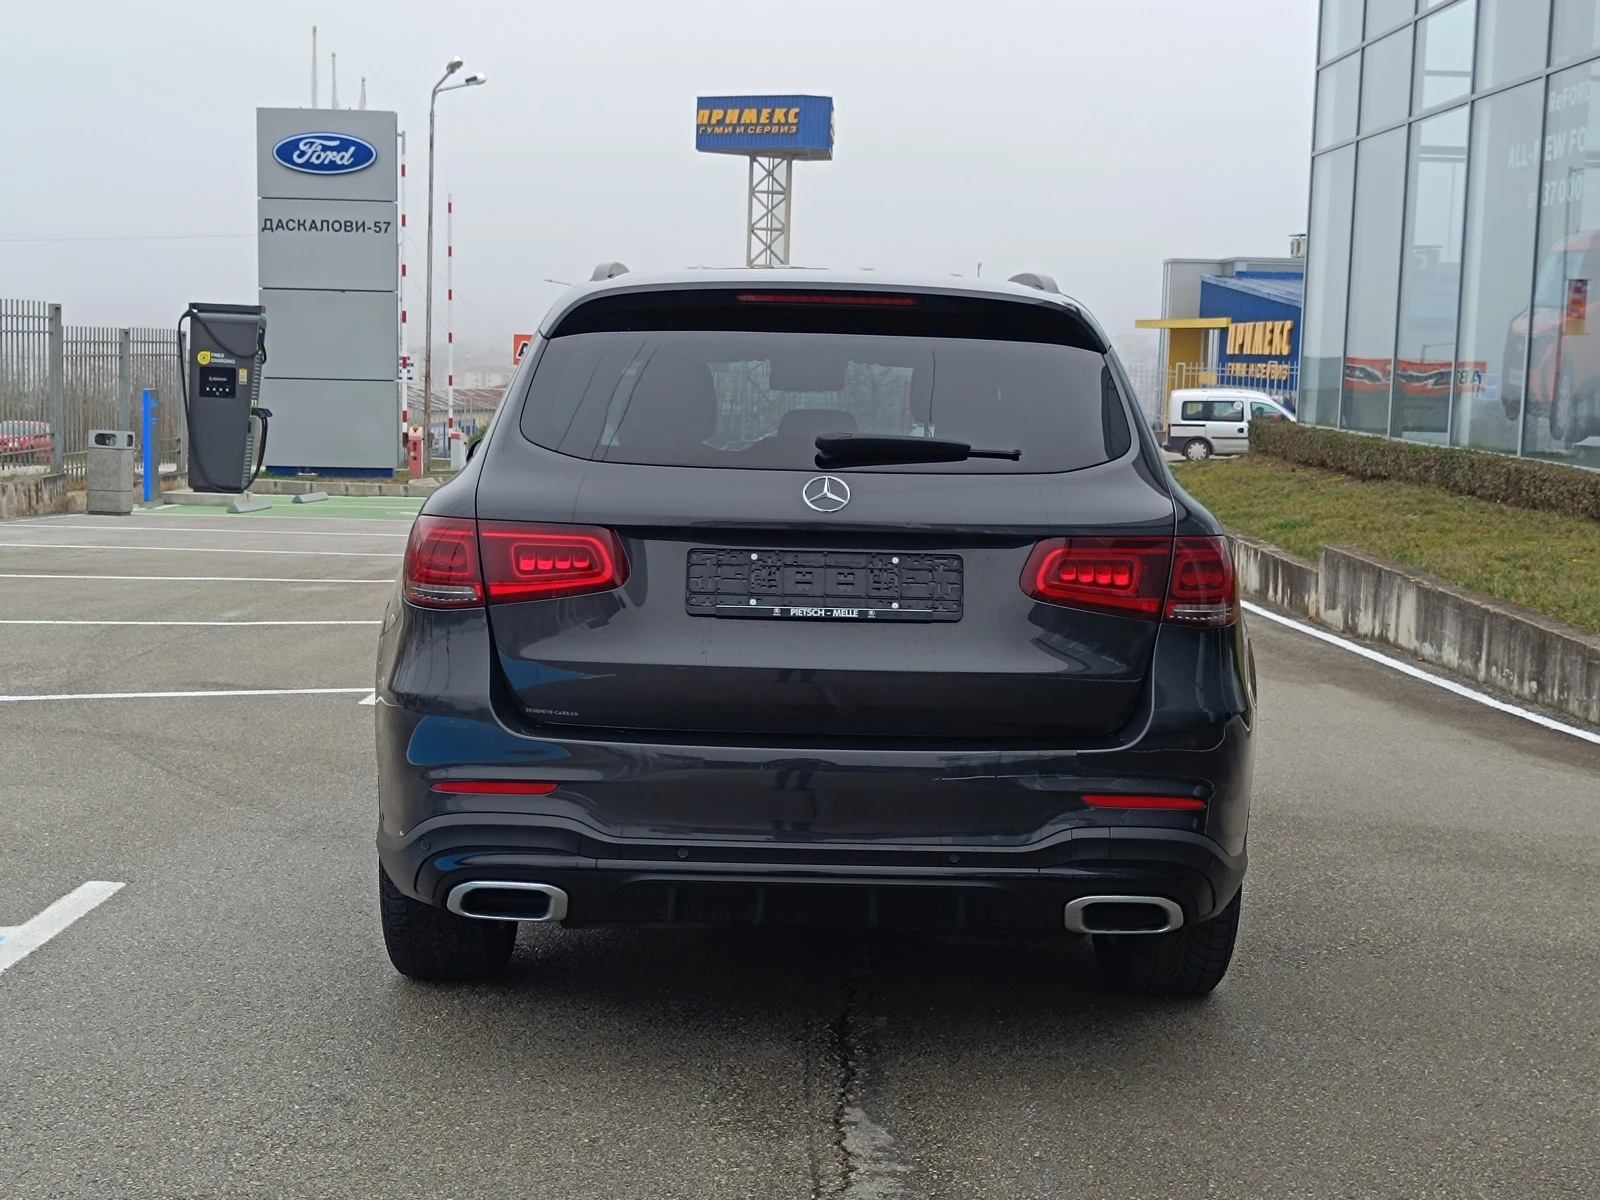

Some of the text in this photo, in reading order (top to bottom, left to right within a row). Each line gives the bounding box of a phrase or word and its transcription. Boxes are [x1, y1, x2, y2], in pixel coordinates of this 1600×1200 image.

[697, 108, 800, 125] ПРИМЕКС
[699, 125, 797, 134] ГУМИ И СЕРВИЗ
[293, 138, 355, 165] Ford
[262, 218, 391, 233] ДАСКАЛОВИ-57
[1226, 320, 1294, 355] ПРИМЕКС
[790, 608, 824, 617] PIETSCH
[832, 609, 859, 618] MELLE
